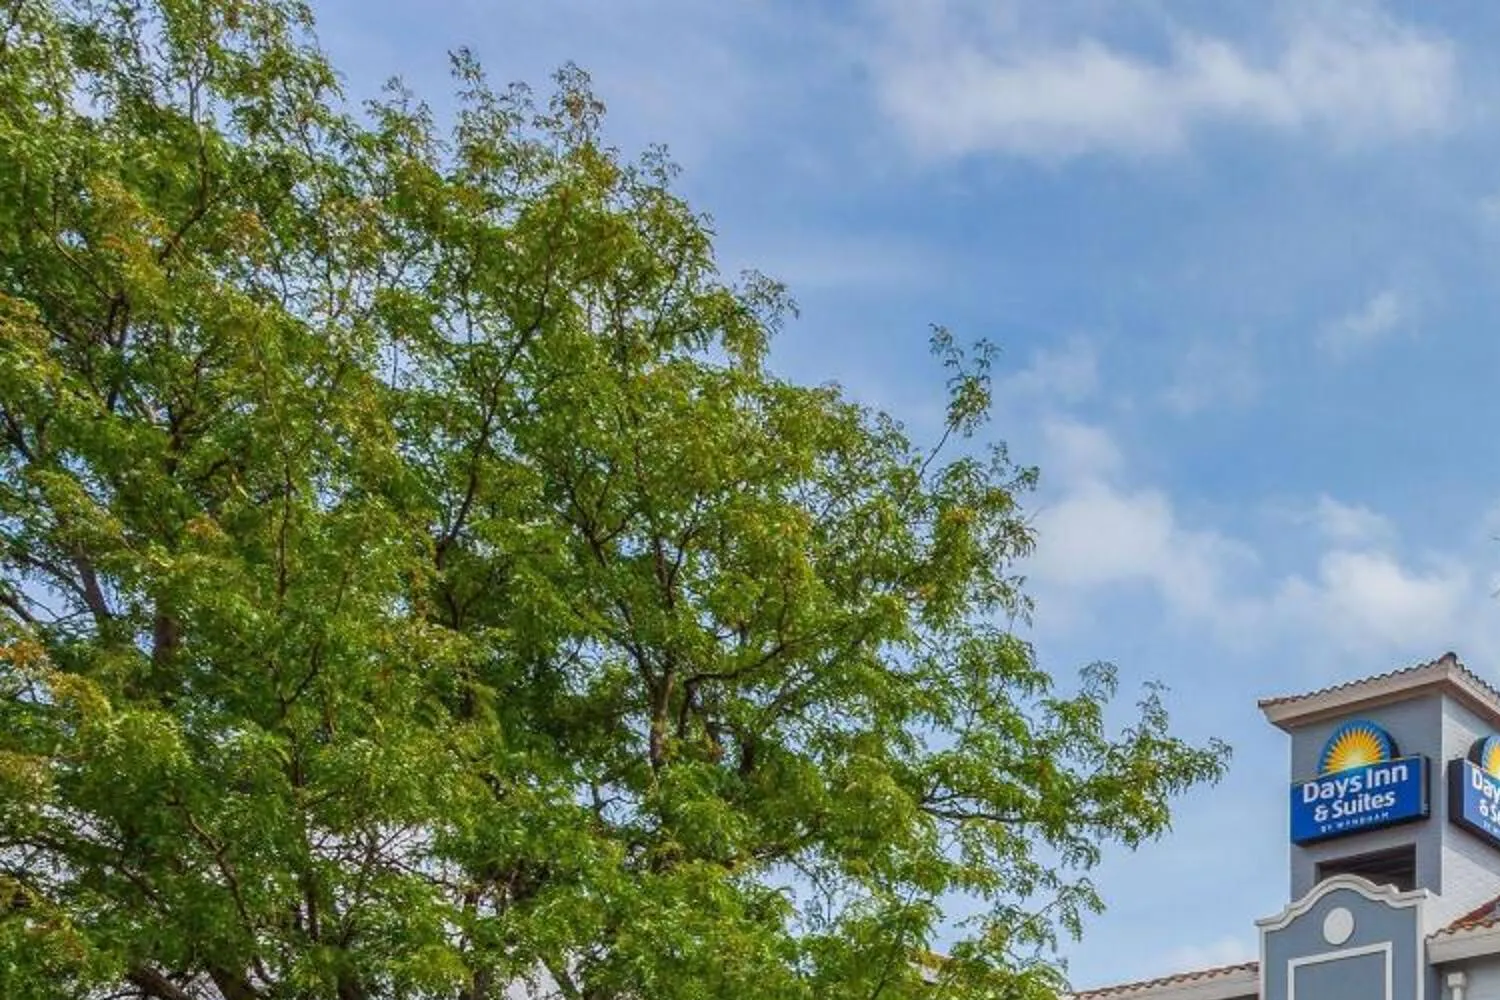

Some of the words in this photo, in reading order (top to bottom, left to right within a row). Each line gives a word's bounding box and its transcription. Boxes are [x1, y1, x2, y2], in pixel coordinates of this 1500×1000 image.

[1303, 775, 1362, 804] Days
[1366, 764, 1408, 789] Inn
[1314, 804, 1328, 822] &
[1331, 791, 1396, 819] Suites
[1480, 799, 1489, 817] &
